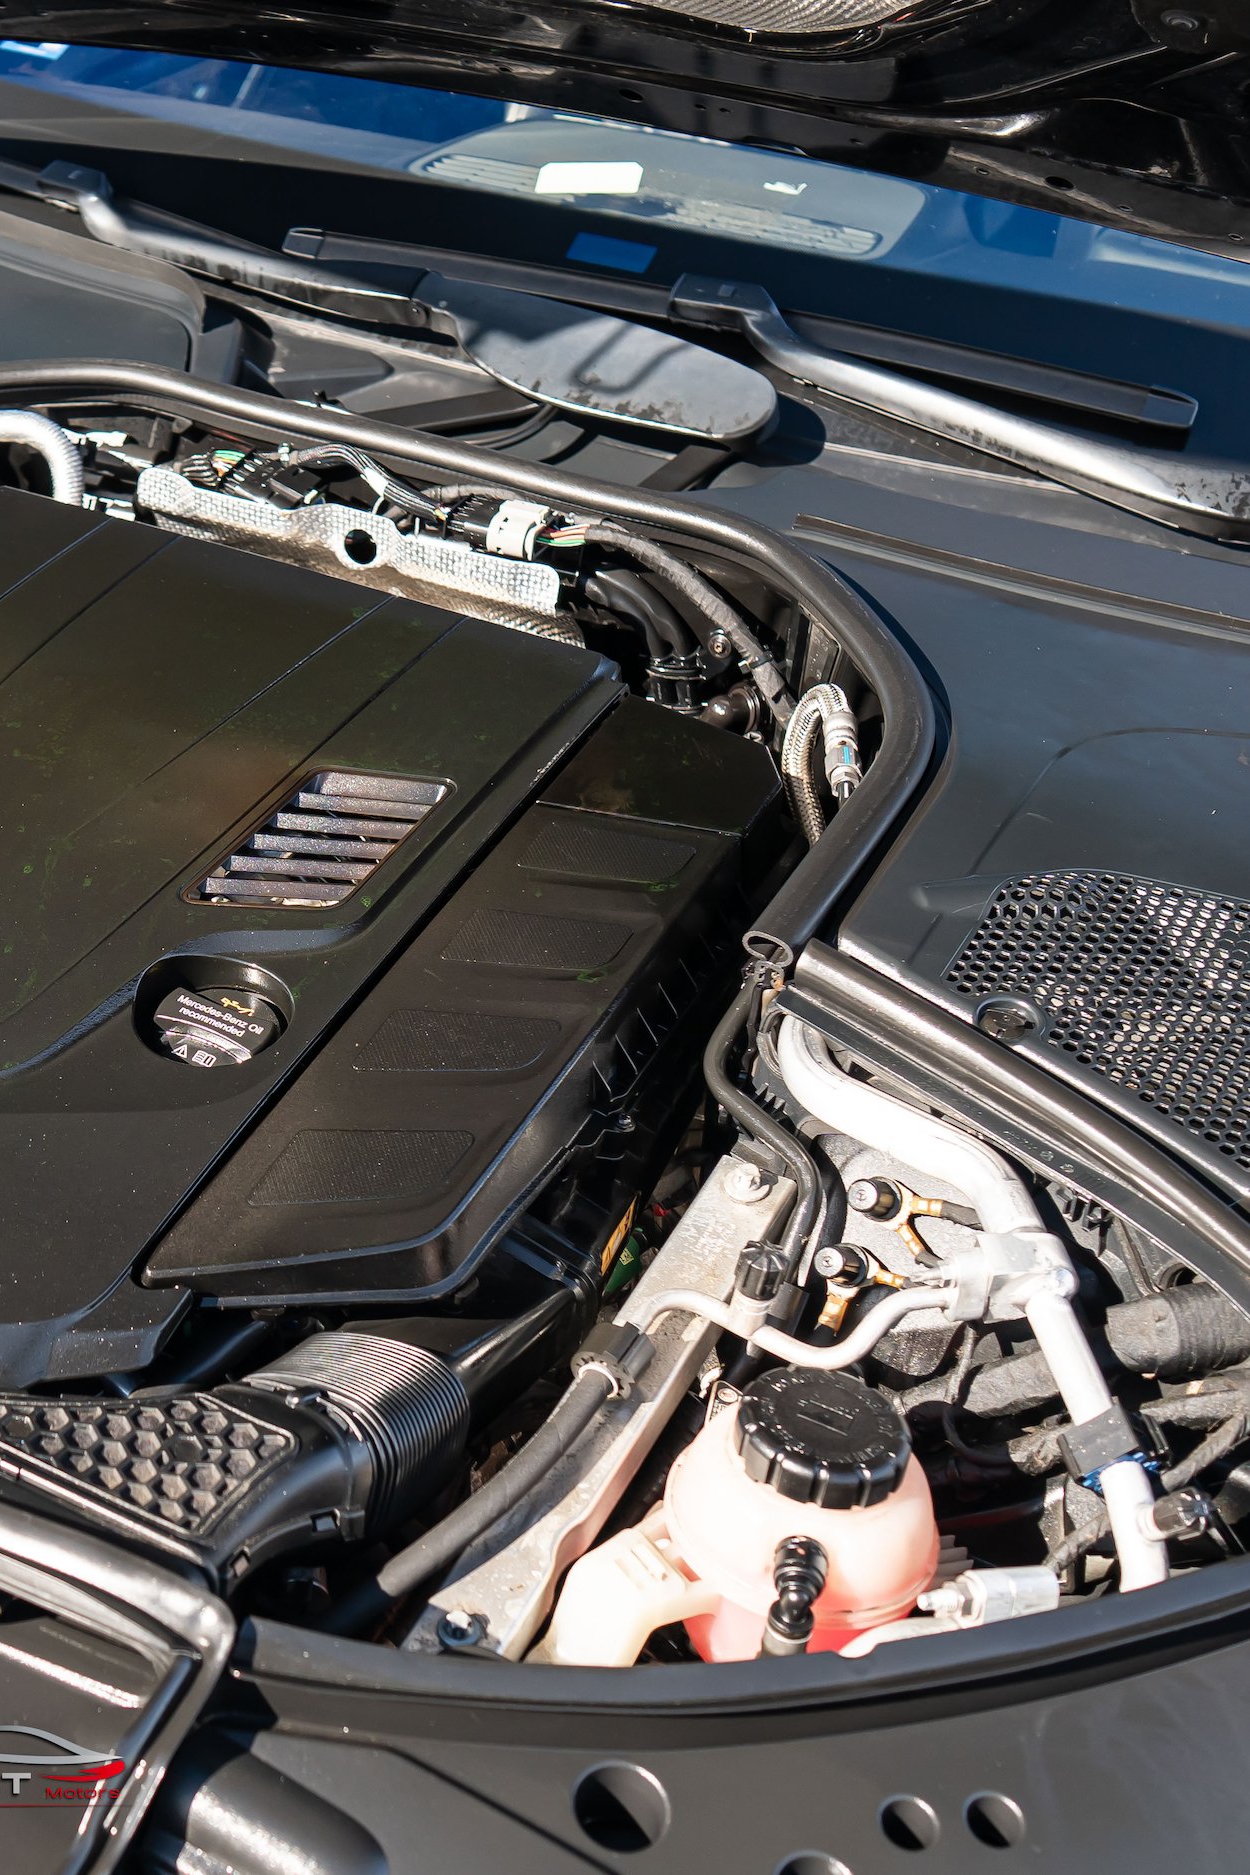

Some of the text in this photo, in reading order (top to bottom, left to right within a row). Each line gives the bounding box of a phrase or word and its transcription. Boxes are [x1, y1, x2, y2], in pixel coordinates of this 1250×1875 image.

[177, 994, 264, 1035] Mercedes-Benz Oil
[179, 1007, 245, 1037] recommended
